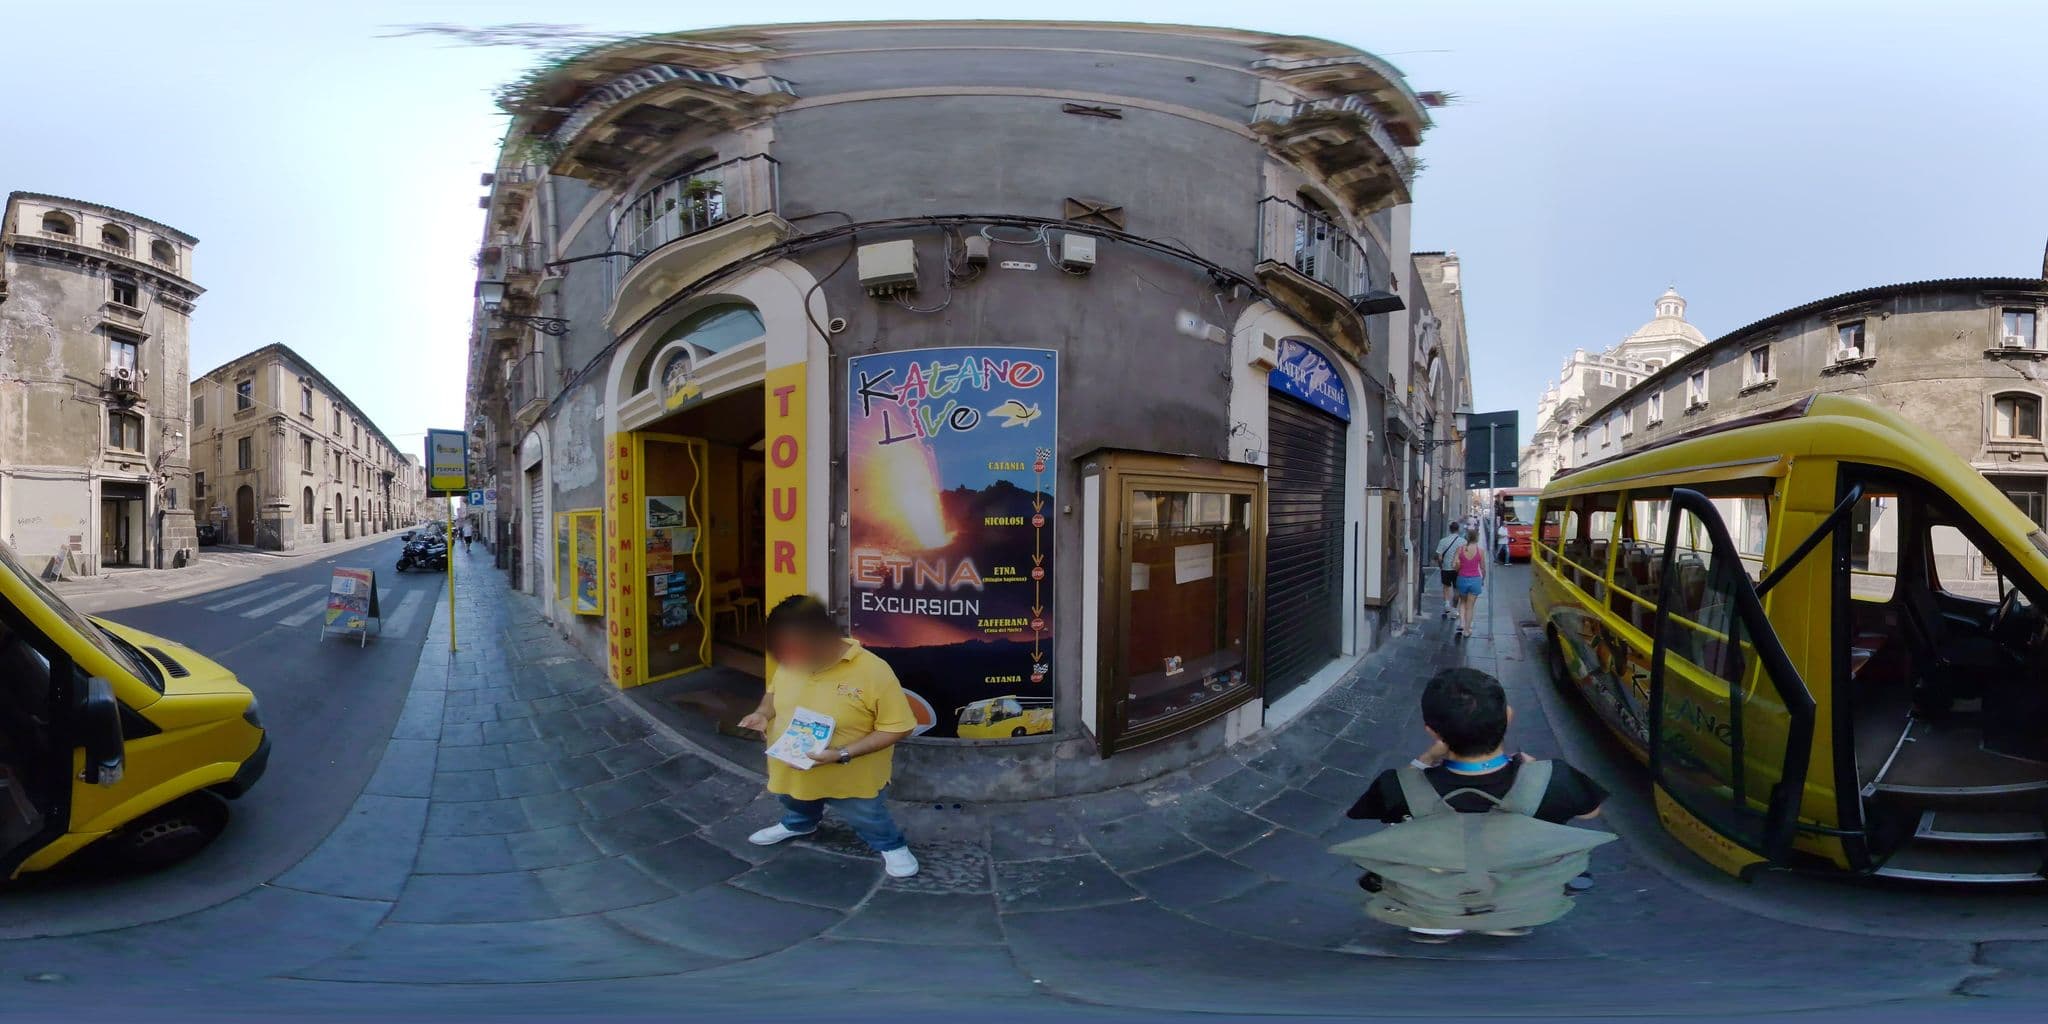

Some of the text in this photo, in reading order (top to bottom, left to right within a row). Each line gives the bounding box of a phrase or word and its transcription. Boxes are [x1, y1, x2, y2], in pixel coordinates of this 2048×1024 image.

[988, 462, 1025, 471] CATANIA
[771, 385, 798, 575] TOUR
[471, 491, 481, 505] P
[984, 516, 1024, 527] NICOLOSI
[608, 440, 620, 680] EXCURSIONS
[620, 447, 633, 676] BUS MINIBUS
[856, 553, 983, 588] ETNA
[994, 566, 1017, 576] ETNA
[862, 592, 979, 616] EXCURSION
[978, 618, 1028, 627] ZAFFERANA
[985, 675, 1022, 683] CATANIA
